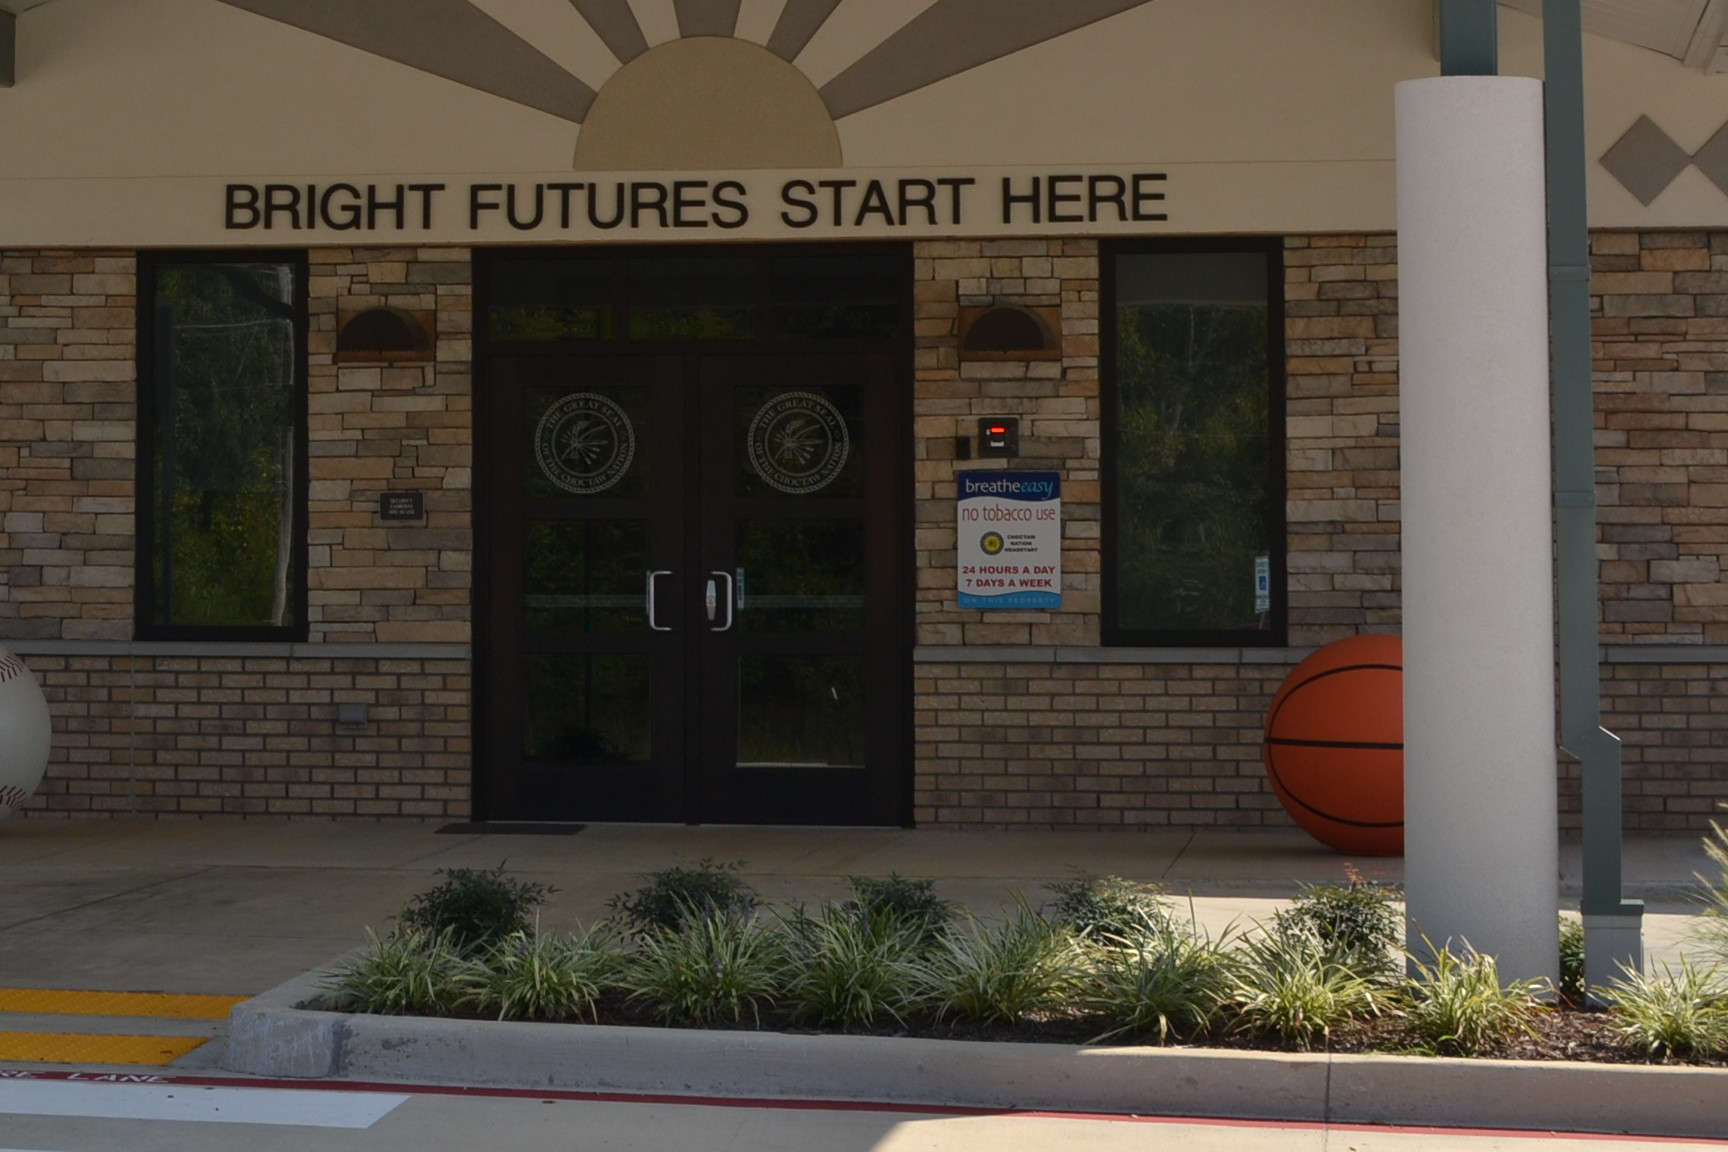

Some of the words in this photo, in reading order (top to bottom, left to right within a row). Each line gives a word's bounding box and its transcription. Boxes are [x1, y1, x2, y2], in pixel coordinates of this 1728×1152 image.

[223, 182, 446, 231] BRIGHT
[469, 180, 751, 231] FUTURES
[780, 178, 977, 228] START
[1001, 173, 1169, 224] HERE
[563, 400, 601, 412] GREAT
[601, 406, 623, 430] SEAL
[759, 409, 777, 428] THE
[777, 399, 815, 412] GREAT
[815, 405, 837, 429] SEAL
[560, 473, 608, 486] CHOCTAW
[607, 443, 628, 476] NATION
[774, 473, 821, 486] CHOCTAW
[820, 442, 842, 475] NATION
[962, 508, 979, 521] no
[983, 504, 1032, 521] tobacco
[1036, 508, 1056, 521] use
[962, 566, 976, 574] 24
[979, 566, 1019, 574] HOURS
[1022, 566, 1030, 574] A
[1034, 566, 1056, 574] DAY
[966, 579, 972, 587] 7
[976, 579, 1005, 587] DAYS
[1008, 579, 1016, 587] A
[1019, 579, 1052, 587] WEEK
[67, 1072, 177, 1084] LANE
